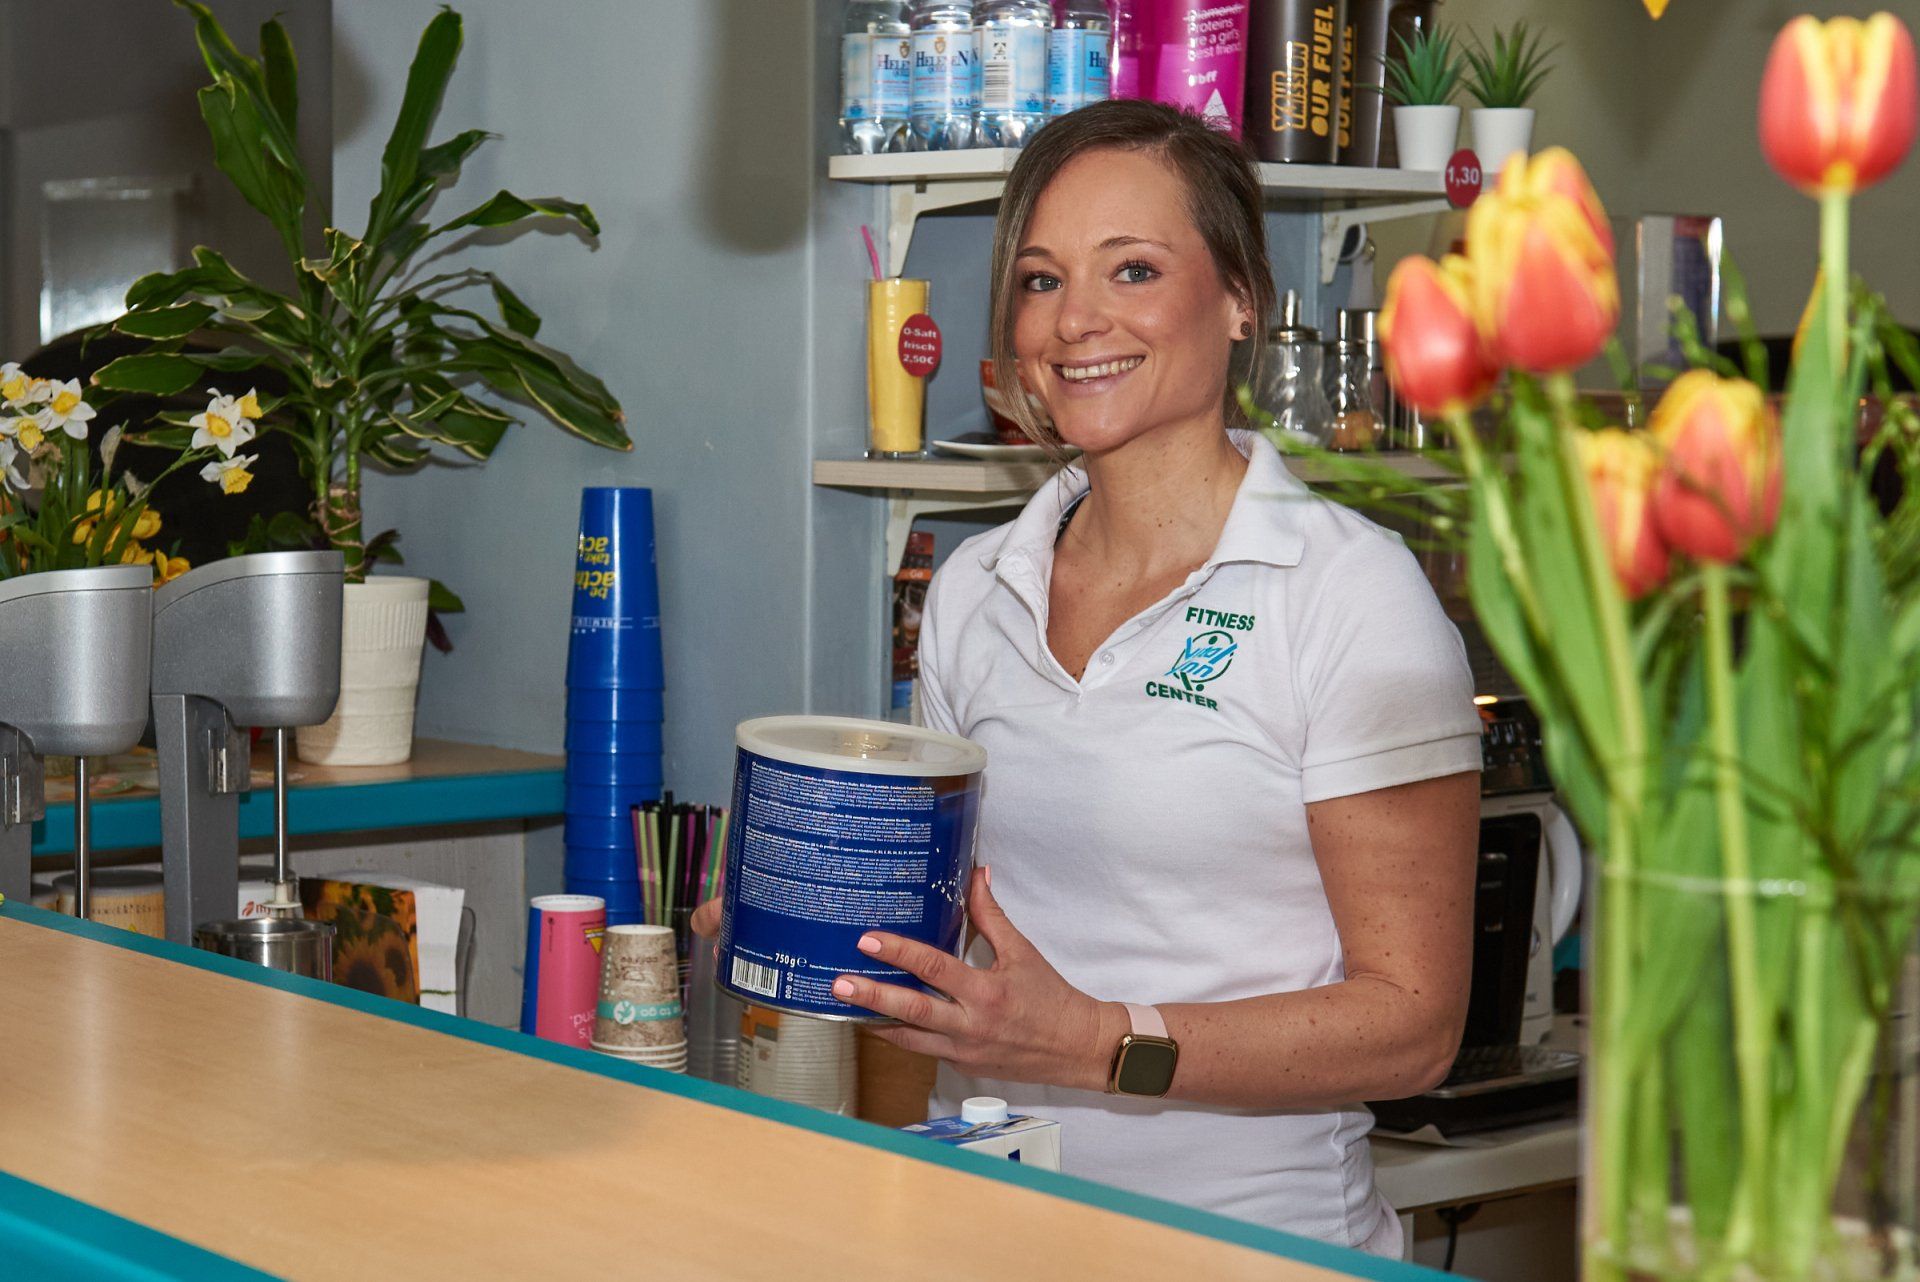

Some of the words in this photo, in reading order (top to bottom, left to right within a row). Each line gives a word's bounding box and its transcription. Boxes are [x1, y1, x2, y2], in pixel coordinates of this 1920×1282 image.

[1312, 4, 1335, 73] FUEL
[1310, 78, 1331, 137] OUR
[1448, 165, 1480, 188] 1,30
[903, 327, 937, 339] O-Saft
[904, 341, 935, 351] frisch
[1185, 606, 1256, 632] FITNESS
[1145, 681, 1219, 711] CENTER
[775, 952, 790, 965] 750
